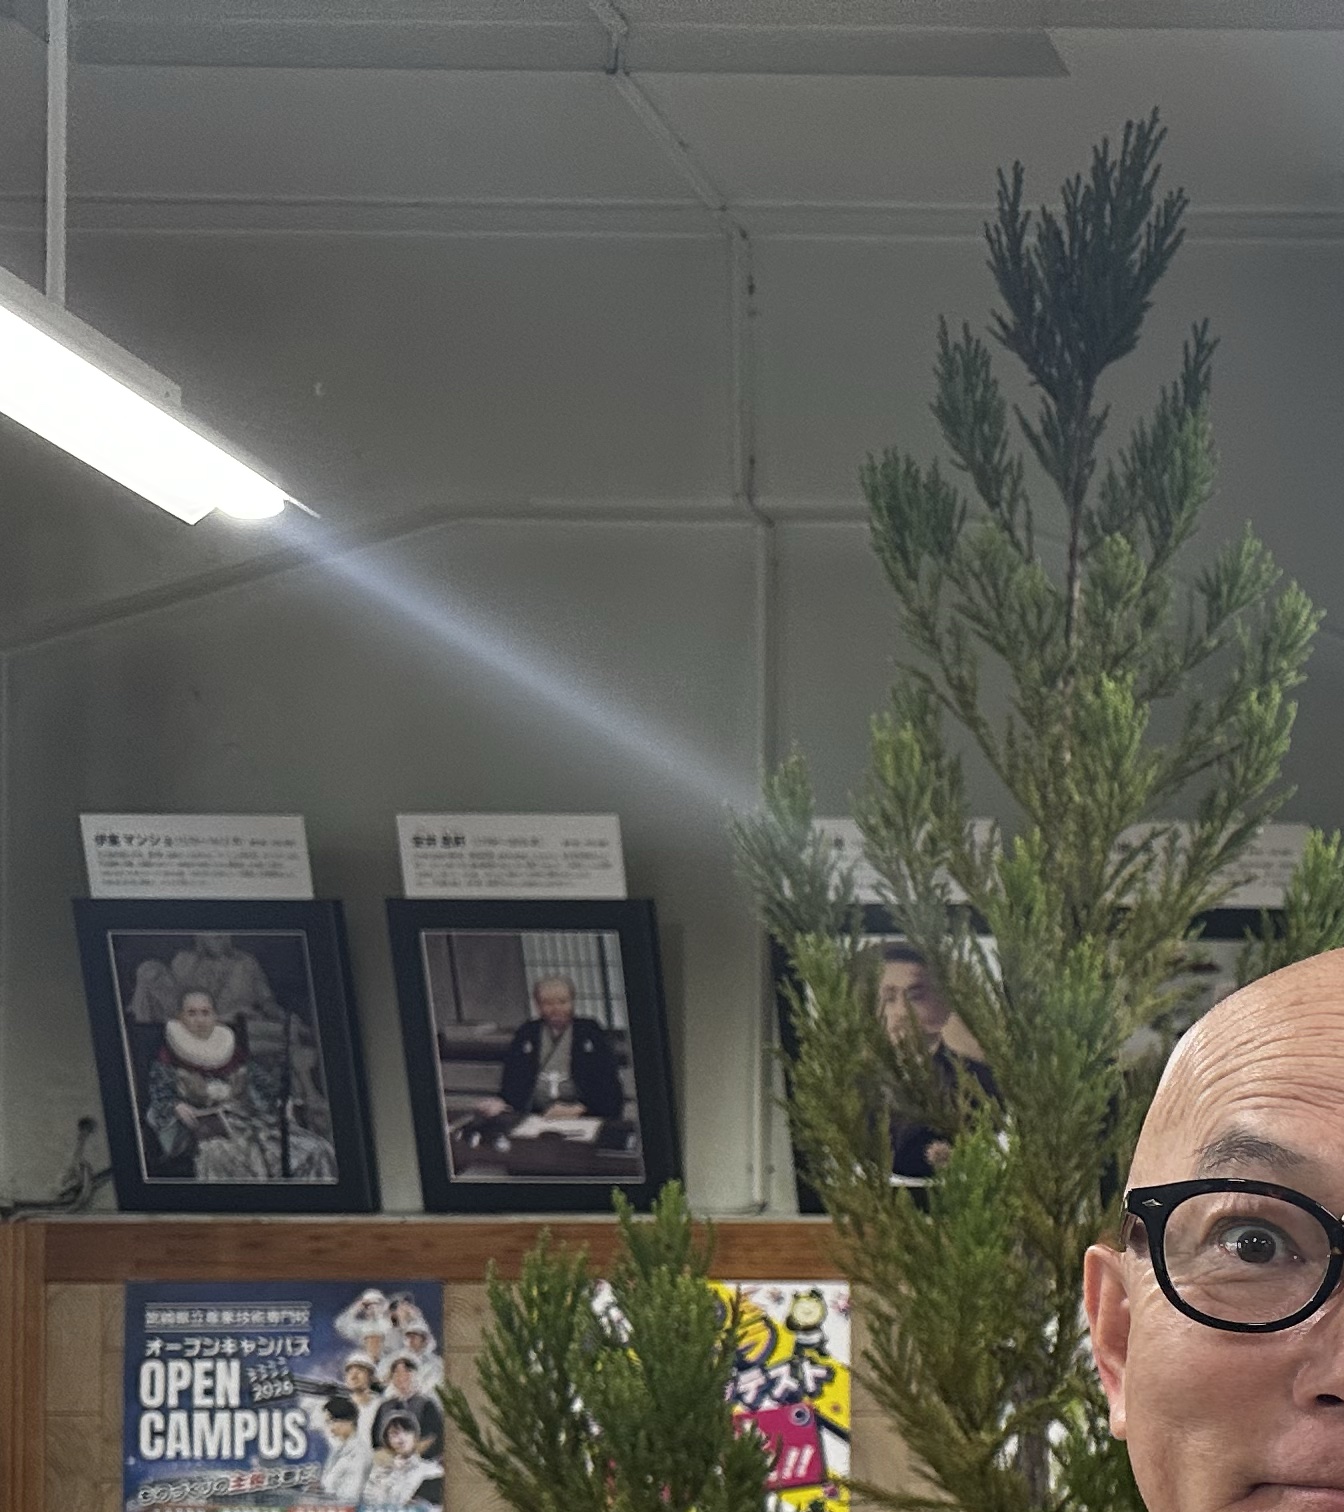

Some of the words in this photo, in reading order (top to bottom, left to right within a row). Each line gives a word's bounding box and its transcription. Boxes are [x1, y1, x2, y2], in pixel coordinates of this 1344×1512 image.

[145, 1335, 312, 1357] オープンキャンパス
[139, 1358, 241, 1409] OPEN
[724, 1361, 829, 1403] ラスト
[139, 1410, 308, 1461] CAMPUS
